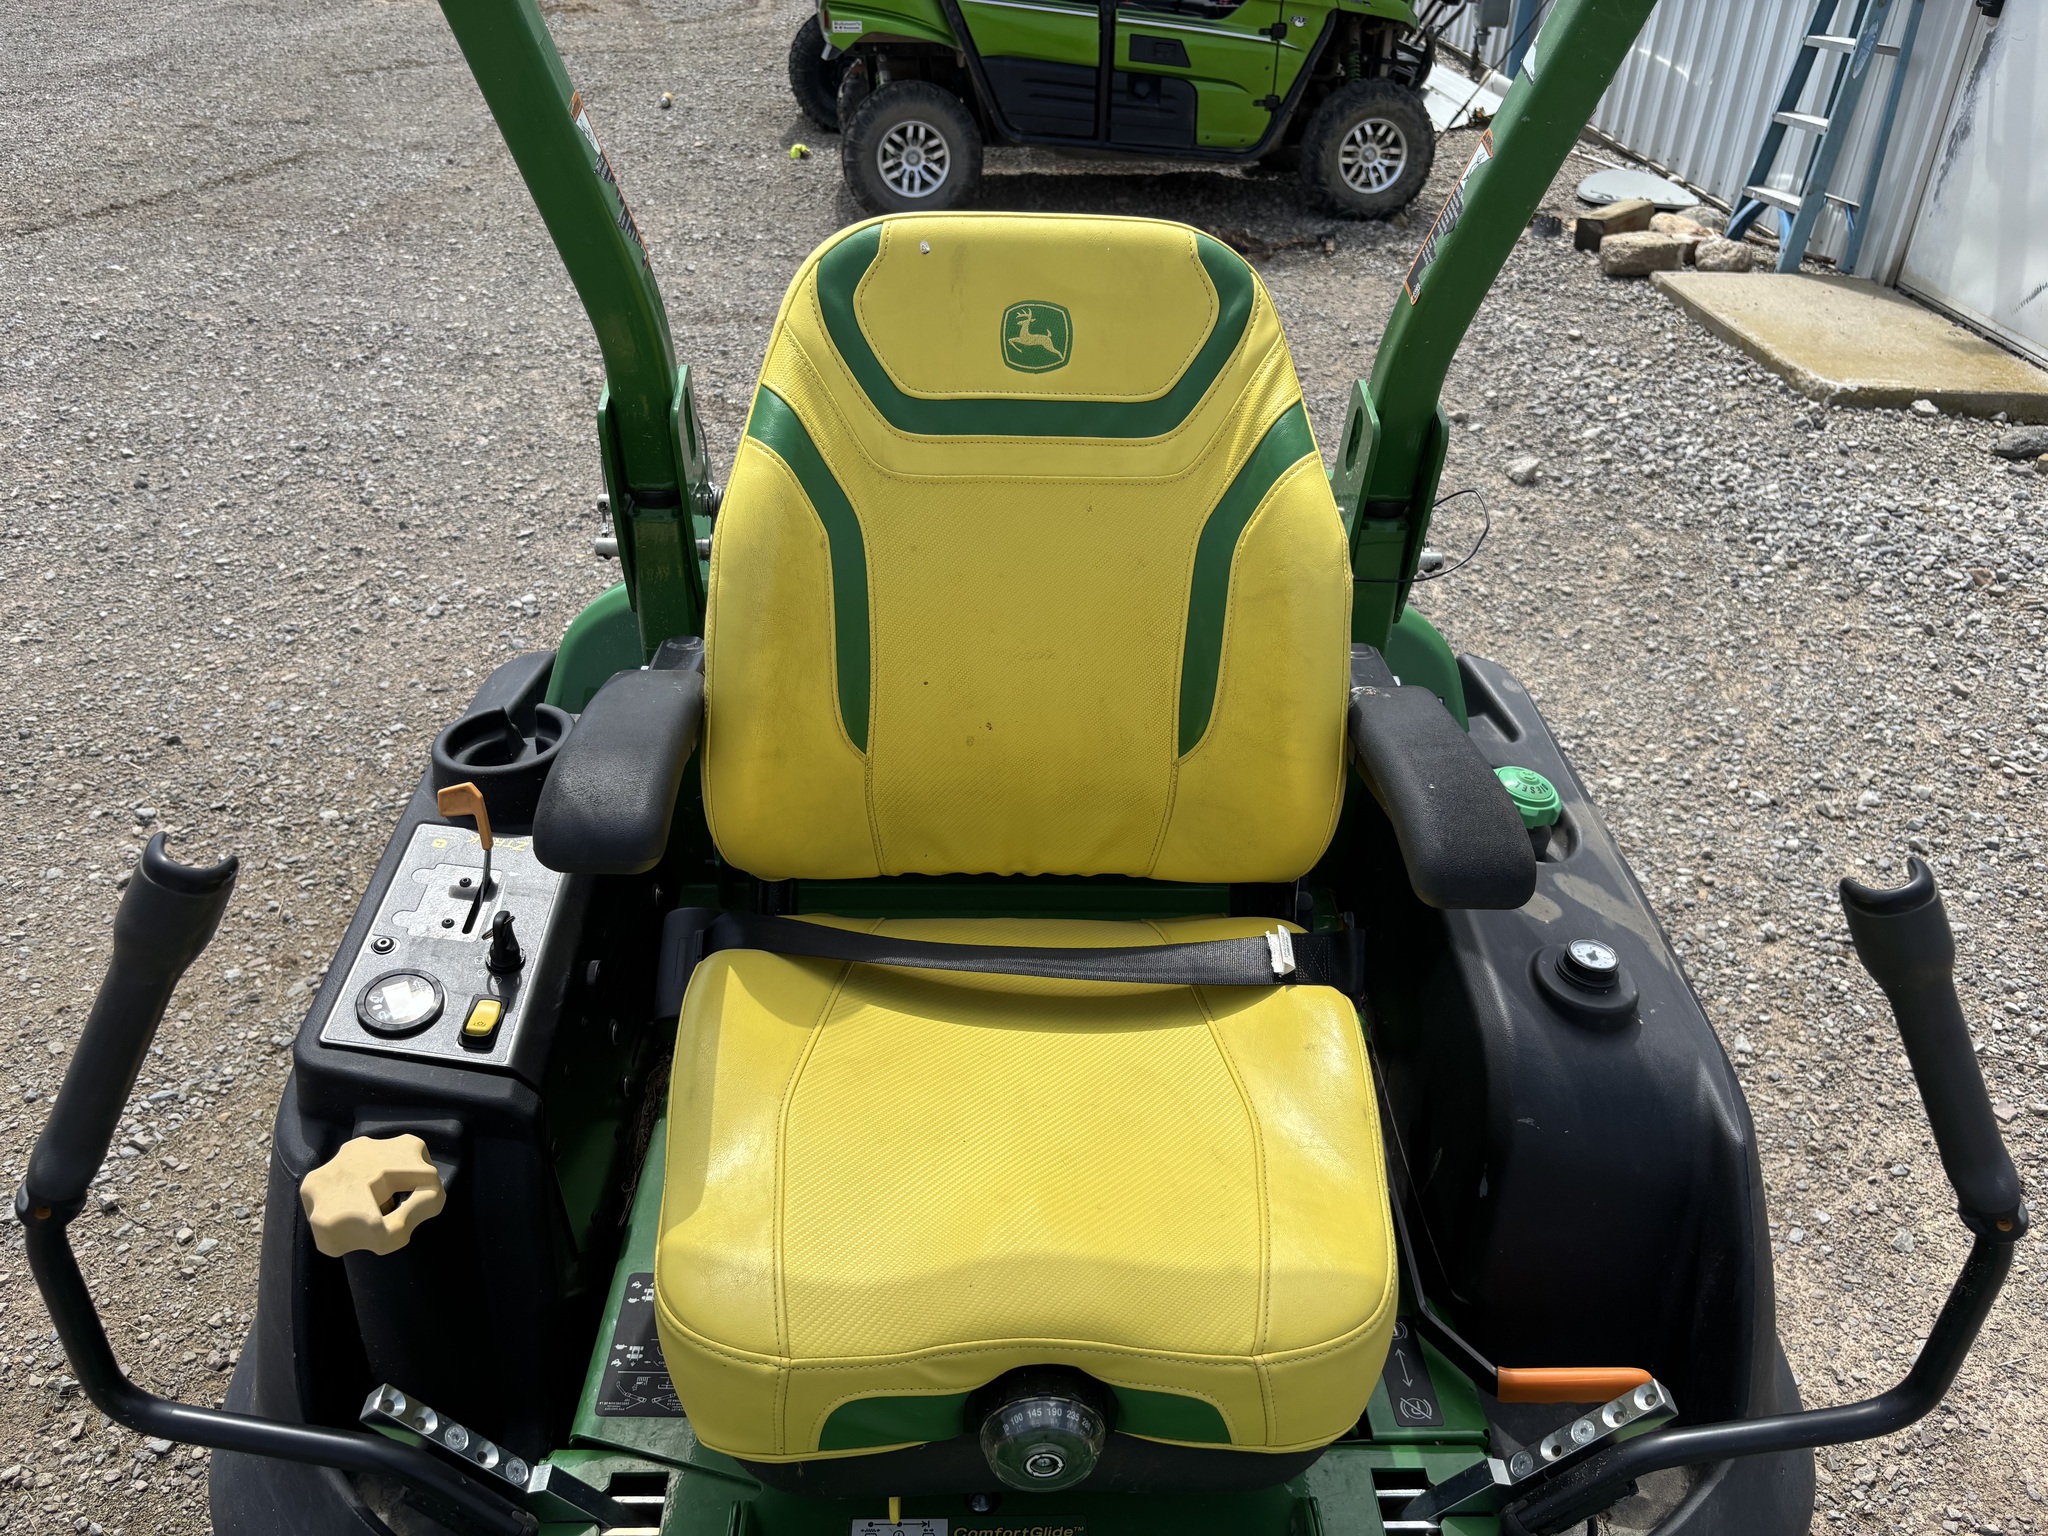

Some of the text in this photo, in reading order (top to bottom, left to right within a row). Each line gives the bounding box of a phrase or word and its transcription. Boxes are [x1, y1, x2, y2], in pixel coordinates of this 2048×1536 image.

[1515, 781, 1549, 795] DIESEL
[467, 833, 530, 852] ZTRK
[1010, 1412, 1023, 1426] 100
[1027, 1407, 1043, 1419] 145
[1046, 1407, 1063, 1417] 190
[1066, 1409, 1080, 1422] 235
